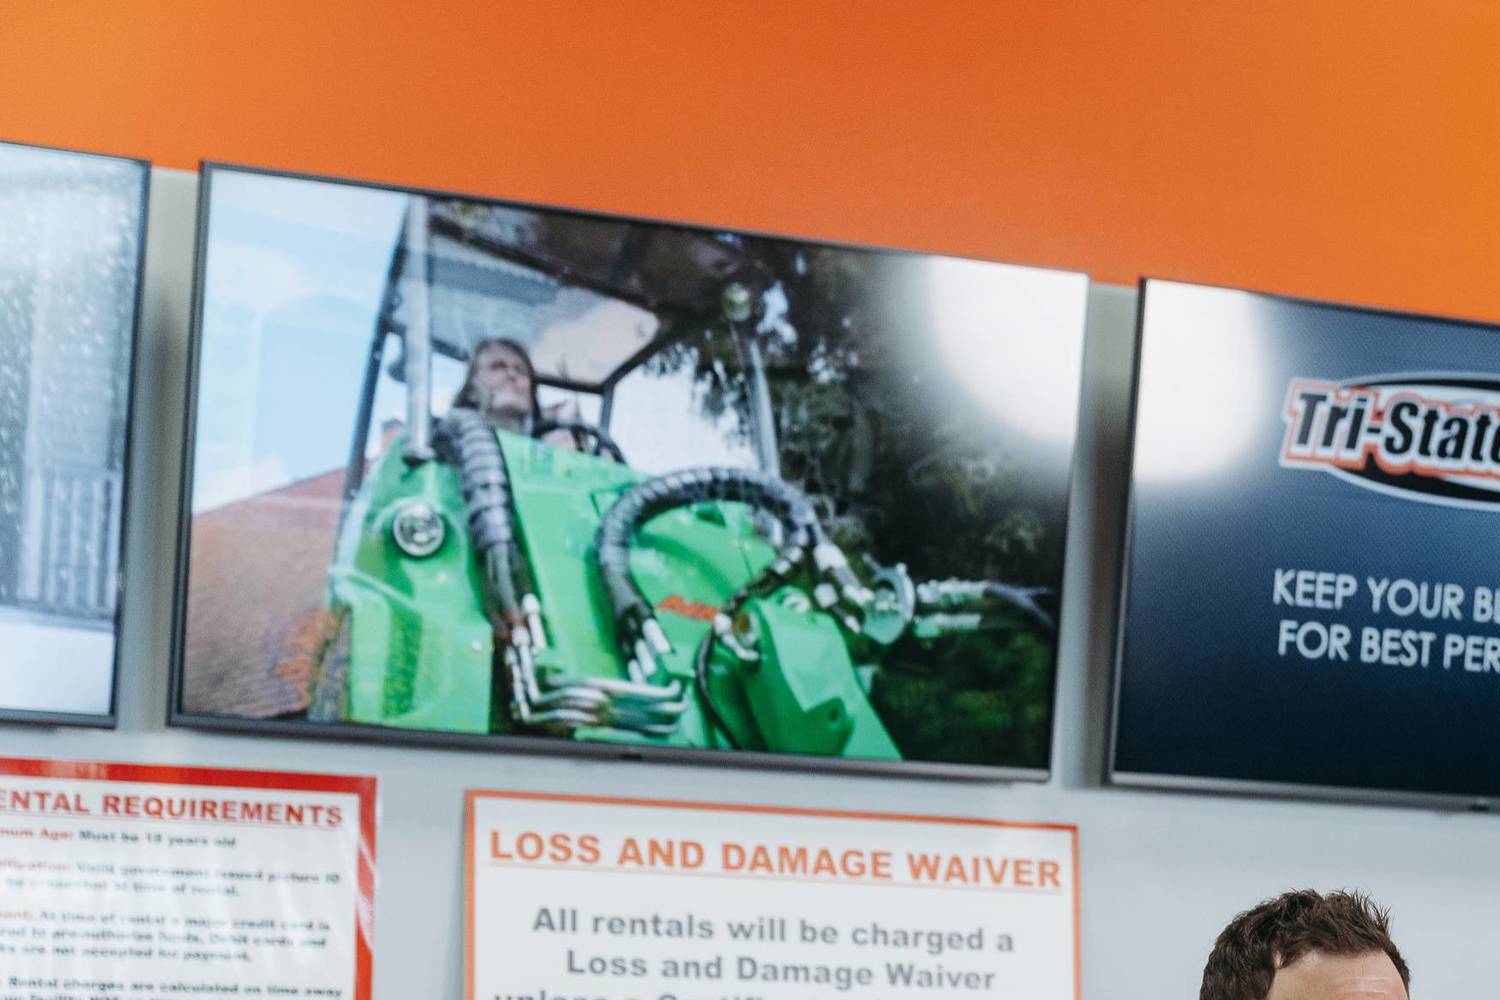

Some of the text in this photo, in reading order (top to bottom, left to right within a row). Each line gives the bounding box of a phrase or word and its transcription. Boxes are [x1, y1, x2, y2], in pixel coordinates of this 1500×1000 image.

[1273, 569, 1357, 609] KEEP
[1366, 577, 1463, 620] YOUR
[1278, 620, 1350, 661] FOR
[1360, 628, 1436, 668] BEST
[102, 794, 343, 826] REQUIREMENTS
[490, 829, 1062, 888] LOSS AND DAMAGE WAIVER
[532, 907, 1015, 954] All rentals will be charged a
[567, 950, 995, 990] Loss and Damage Waiver
